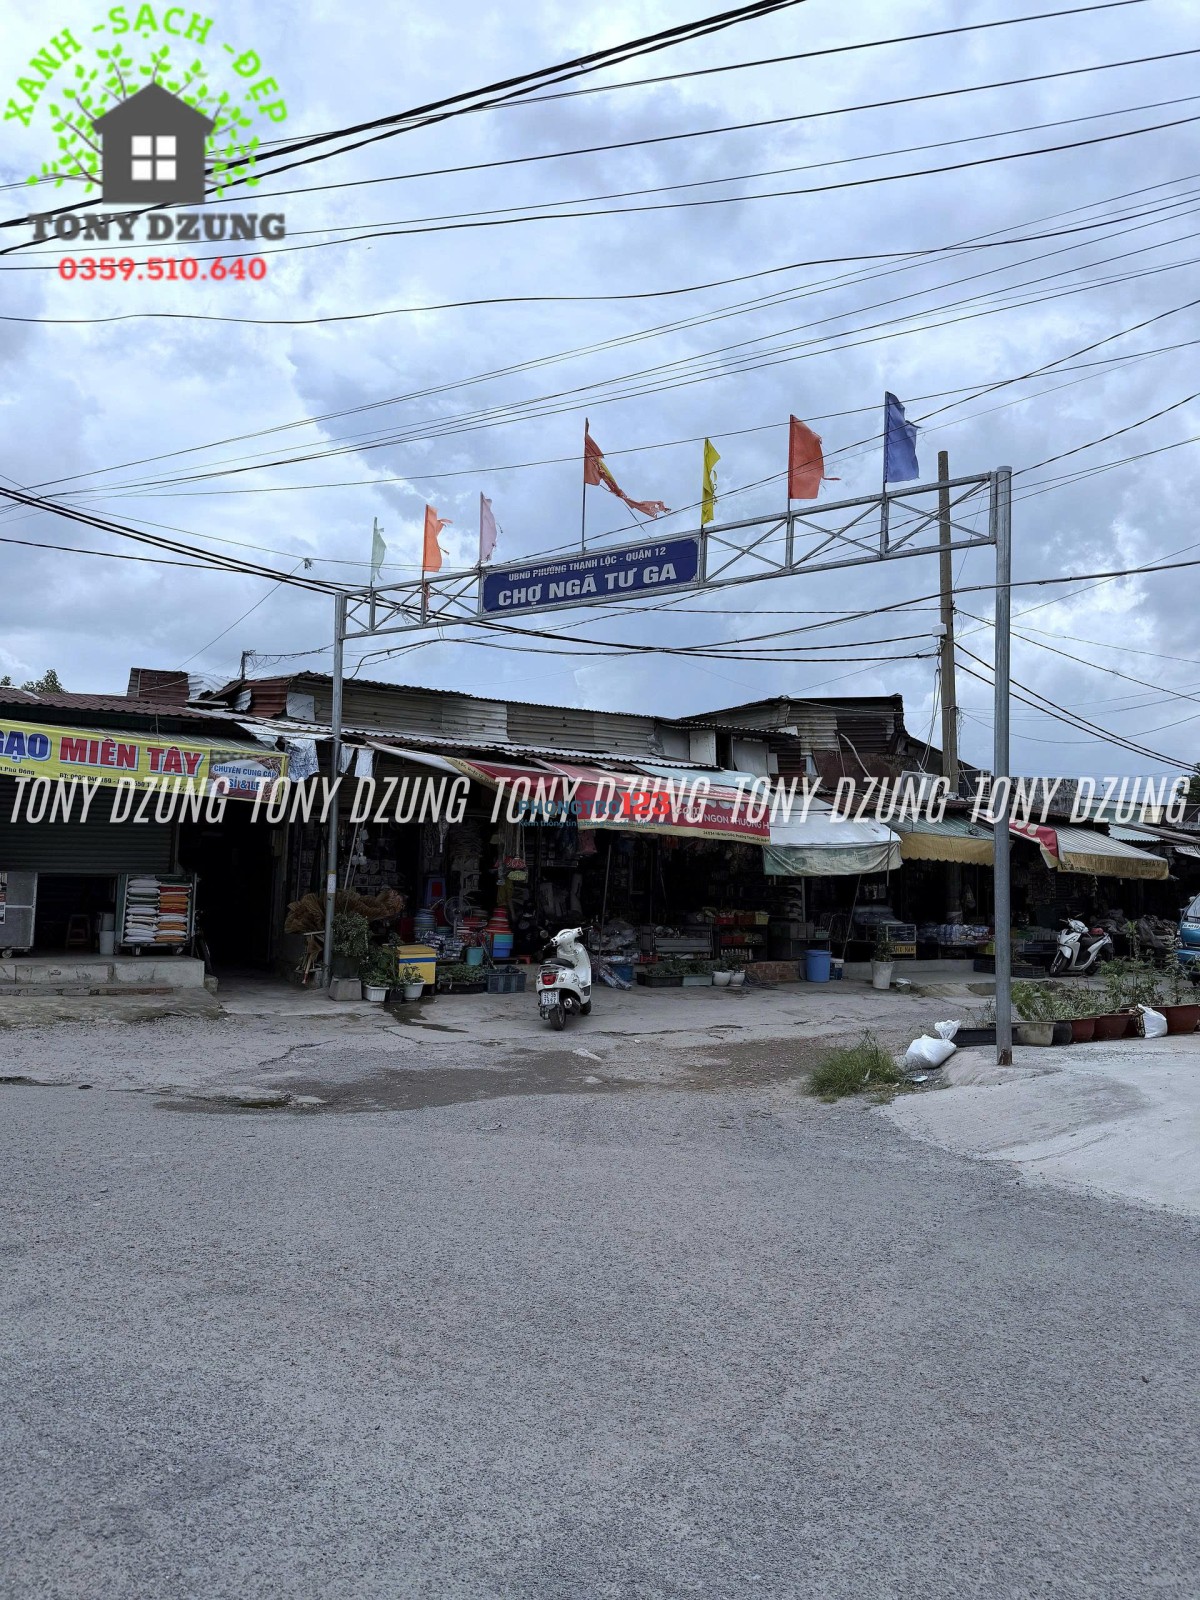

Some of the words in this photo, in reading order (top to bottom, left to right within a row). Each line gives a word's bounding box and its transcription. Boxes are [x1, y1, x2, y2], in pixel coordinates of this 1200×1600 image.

[569, 560, 598, 572] THẠNH
[600, 555, 617, 568] LỘC
[626, 549, 652, 562] QUẬN
[655, 547, 666, 556] 12
[498, 583, 543, 606] CHỢ
[548, 573, 598, 594] NGÃ
[605, 567, 637, 590] TƯ
[643, 563, 677, 584] GA
[0, 730, 51, 762] ẠO
[146, 746, 204, 776] TÂY
[704, 813, 729, 824] NGON
